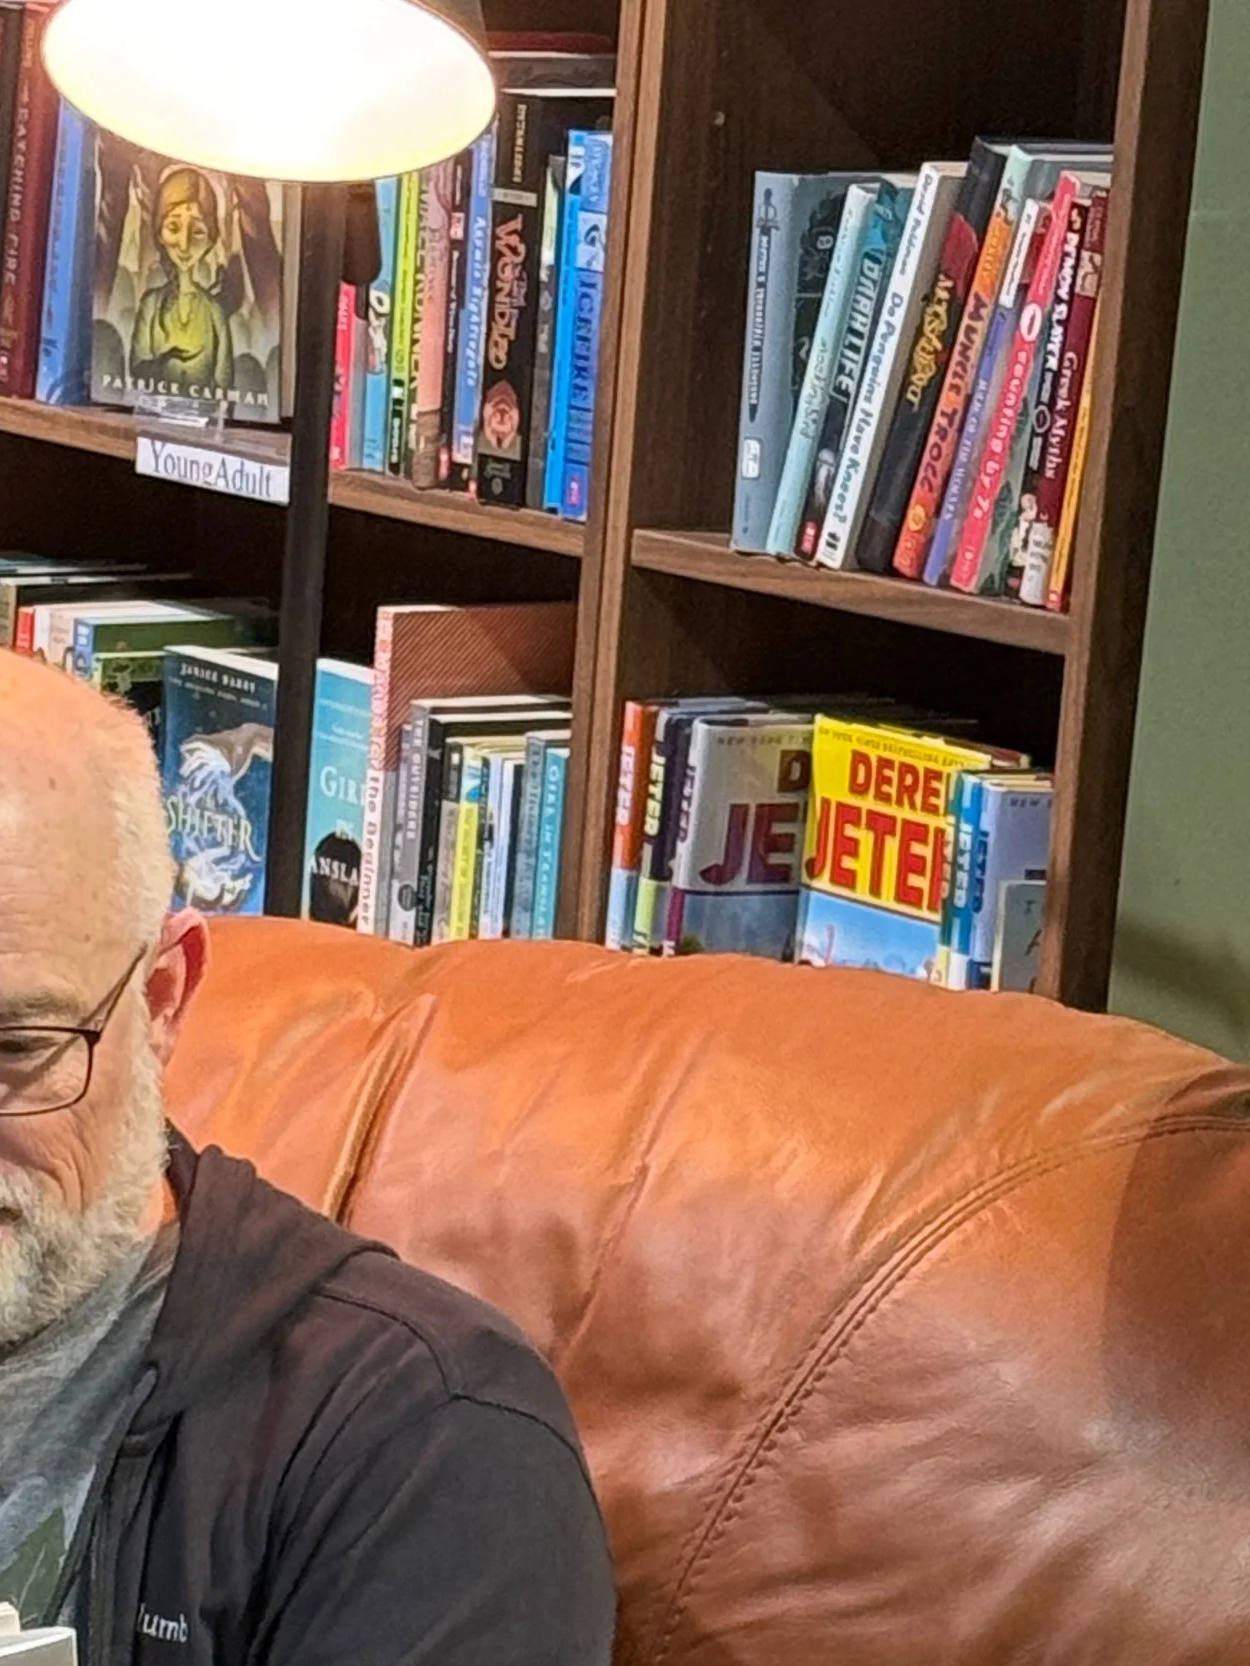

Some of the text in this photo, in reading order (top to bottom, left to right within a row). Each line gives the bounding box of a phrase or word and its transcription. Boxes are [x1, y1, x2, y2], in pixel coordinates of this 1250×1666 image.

[886, 292, 905, 318] Do
[946, 291, 990, 397] MUNCLE
[101, 373, 180, 395] PATRICK
[835, 334, 863, 394] LIFE
[858, 320, 896, 405] Penguins
[848, 406, 875, 456] Have
[971, 350, 1028, 521] counting by 7s
[1043, 351, 1080, 480] Greek Myths
[830, 457, 862, 525] Knees?
[367, 774, 382, 813] the
[405, 717, 426, 842] THE OUTSIDERS
[541, 763, 561, 816] GIRL
[644, 747, 667, 836] JETER
[777, 749, 812, 794] D
[849, 748, 945, 818] DERE
[166, 794, 263, 860] SHIFTER
[699, 802, 801, 885] JE
[951, 820, 974, 909] JETER
[360, 820, 380, 927] Beginner
[535, 849, 554, 938] TRANSLAT
[971, 829, 991, 915] JETER
